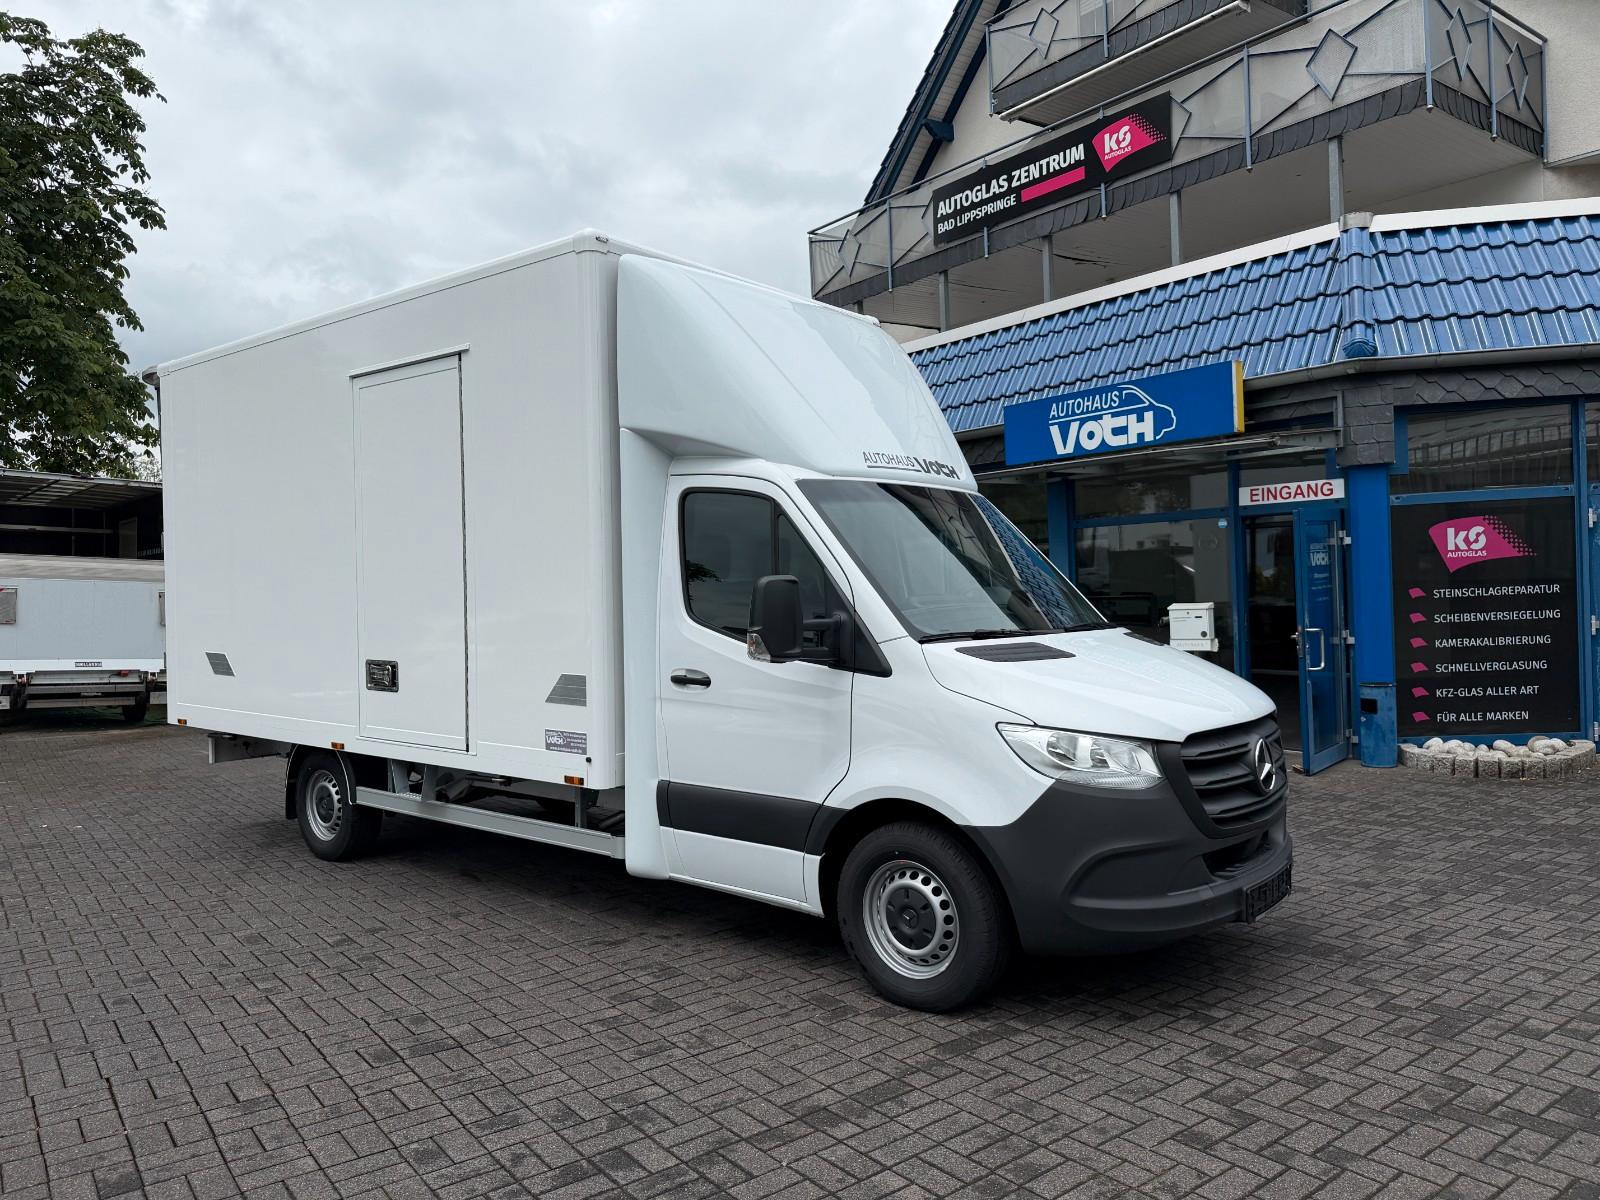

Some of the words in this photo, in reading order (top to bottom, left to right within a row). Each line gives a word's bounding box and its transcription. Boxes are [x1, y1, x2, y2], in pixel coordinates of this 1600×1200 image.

[1104, 146, 1132, 160] AUTOGLAS
[937, 175, 1008, 218] AUTOGLAS
[1012, 143, 1085, 188] ZENTRUM
[937, 219, 955, 234] BAD
[957, 194, 1017, 227] LIPPSPRINGE
[1049, 388, 1120, 419] AUTOHAUS
[863, 451, 915, 467] AUTOHAUS
[1250, 481, 1334, 502] EINGANG
[1447, 550, 1487, 558] AUTOGLAS
[1433, 584, 1560, 598] STEINSCHLAGREPARATUR
[1434, 609, 1561, 623] SCHEIBENVERSIEGELUNG
[1435, 635, 1551, 648] KAMERAKALIBRIERUNG
[1435, 660, 1548, 673] SCHNELLVERGLASUNG
[1436, 687, 1483, 697] KFZ-GLAS
[1486, 686, 1517, 696] ALLER
[1519, 685, 1539, 695] ART
[1437, 711, 1456, 722] FÜR
[1459, 712, 1483, 722] ALLE
[1486, 710, 1529, 721] MARKEN
